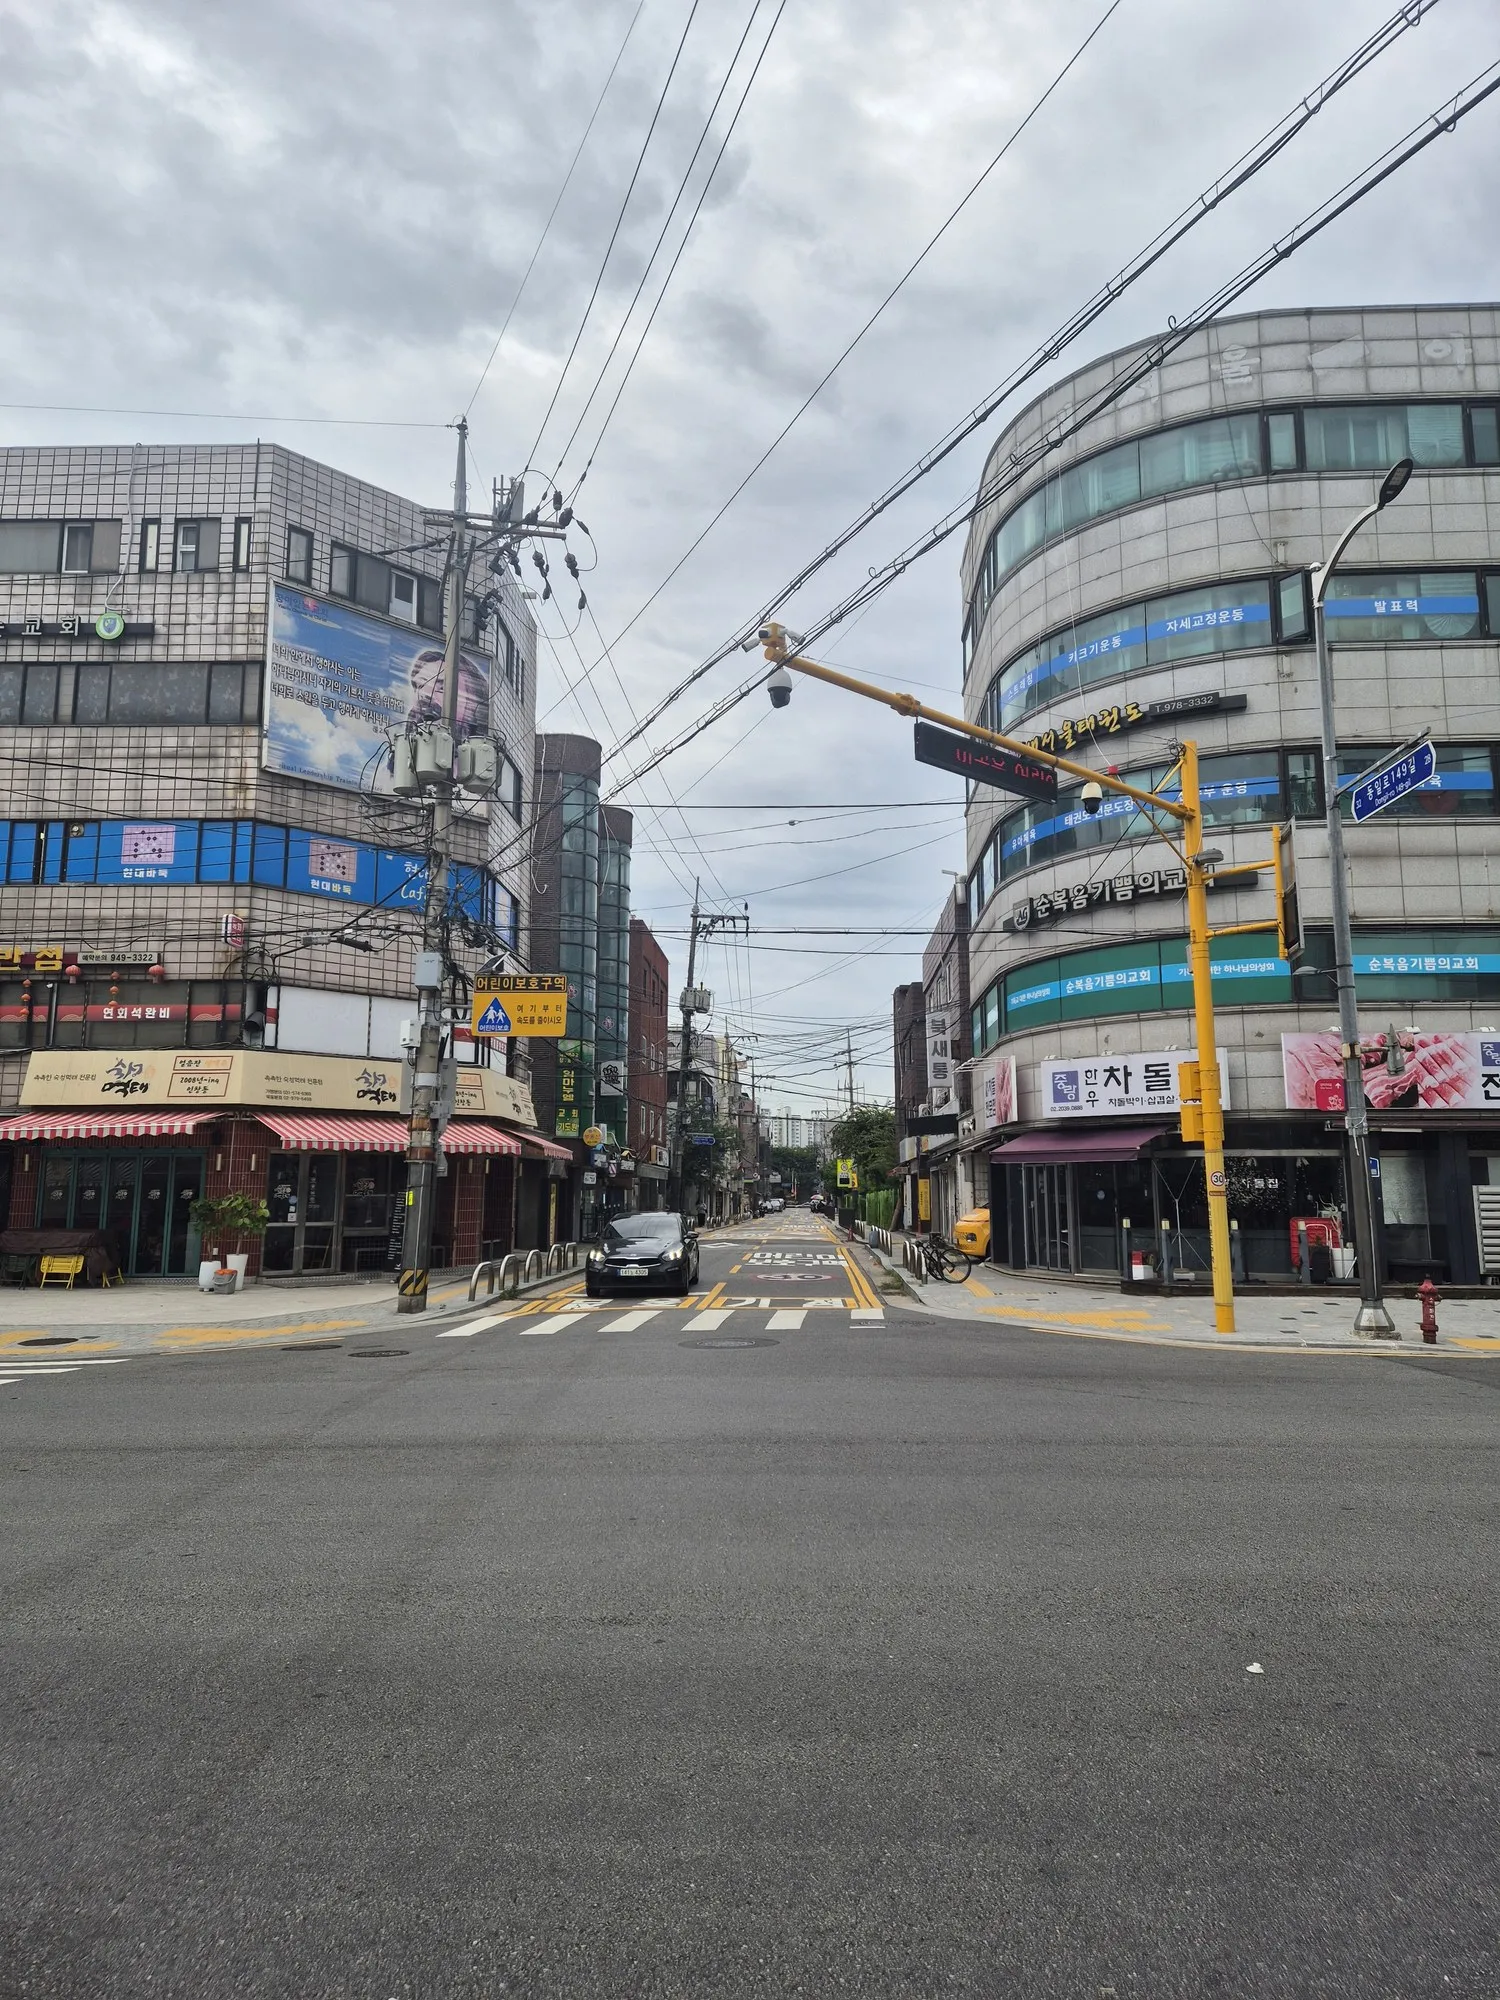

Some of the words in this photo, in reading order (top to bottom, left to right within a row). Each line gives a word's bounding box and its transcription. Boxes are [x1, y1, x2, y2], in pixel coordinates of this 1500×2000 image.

[1374, 600, 1418, 613] 발표력
[1166, 608, 1244, 633] 자세교정운동
[1068, 636, 1123, 663] 키크기운동
[272, 643, 288, 659] 너희
[290, 648, 313, 666] 안에서
[315, 656, 344, 676] 행하시는
[346, 666, 361, 682] 이는
[271, 662, 317, 688] 하나님이시니
[319, 675, 341, 694] 자기의
[367, 690, 381, 706] 뜻을
[1007, 673, 1034, 700] 스트레칭
[271, 682, 294, 699] 너희로
[295, 690, 319, 707] 소원을
[321, 696, 337, 711] 두고
[338, 701, 361, 719] 행하게
[361, 707, 390, 727] 하시나니
[1155, 695, 1214, 713] T.978-3332
[1221, 781, 1247, 796] 운영
[1355, 799, 1362, 810] 32
[1366, 756, 1417, 801] 동일로149길
[1424, 754, 1432, 766] 28
[1374, 790, 1396, 807] Dongil-ro
[1396, 778, 1412, 793] 149-gil
[1064, 809, 1092, 826] 태권도
[1011, 828, 1036, 850] 유아체육
[123, 868, 168, 878] 현대바둑
[310, 879, 352, 896] 현대바둑
[401, 884, 427, 901] Caf
[82, 954, 108, 962] 예약문의
[110, 953, 154, 963] 949-3322
[1369, 957, 1478, 971] 순복음기쁨의교회
[1224, 962, 1275, 973] 하나님의성회
[477, 977, 565, 990] 어린이보호구역
[1066, 969, 1151, 994] 순복음기쁨의교회
[103, 1007, 170, 1019] 연회석완비
[516, 1016, 535, 1025] 속도를
[537, 1016, 562, 1025] 줄이시오
[479, 1024, 509, 1032] 어린이보호
[930, 1018, 948, 1080] 북새통
[1054, 1073, 1078, 1101] 중랑
[557, 1122, 579, 1132] 기도원
[1213, 1174, 1223, 1184] 30
